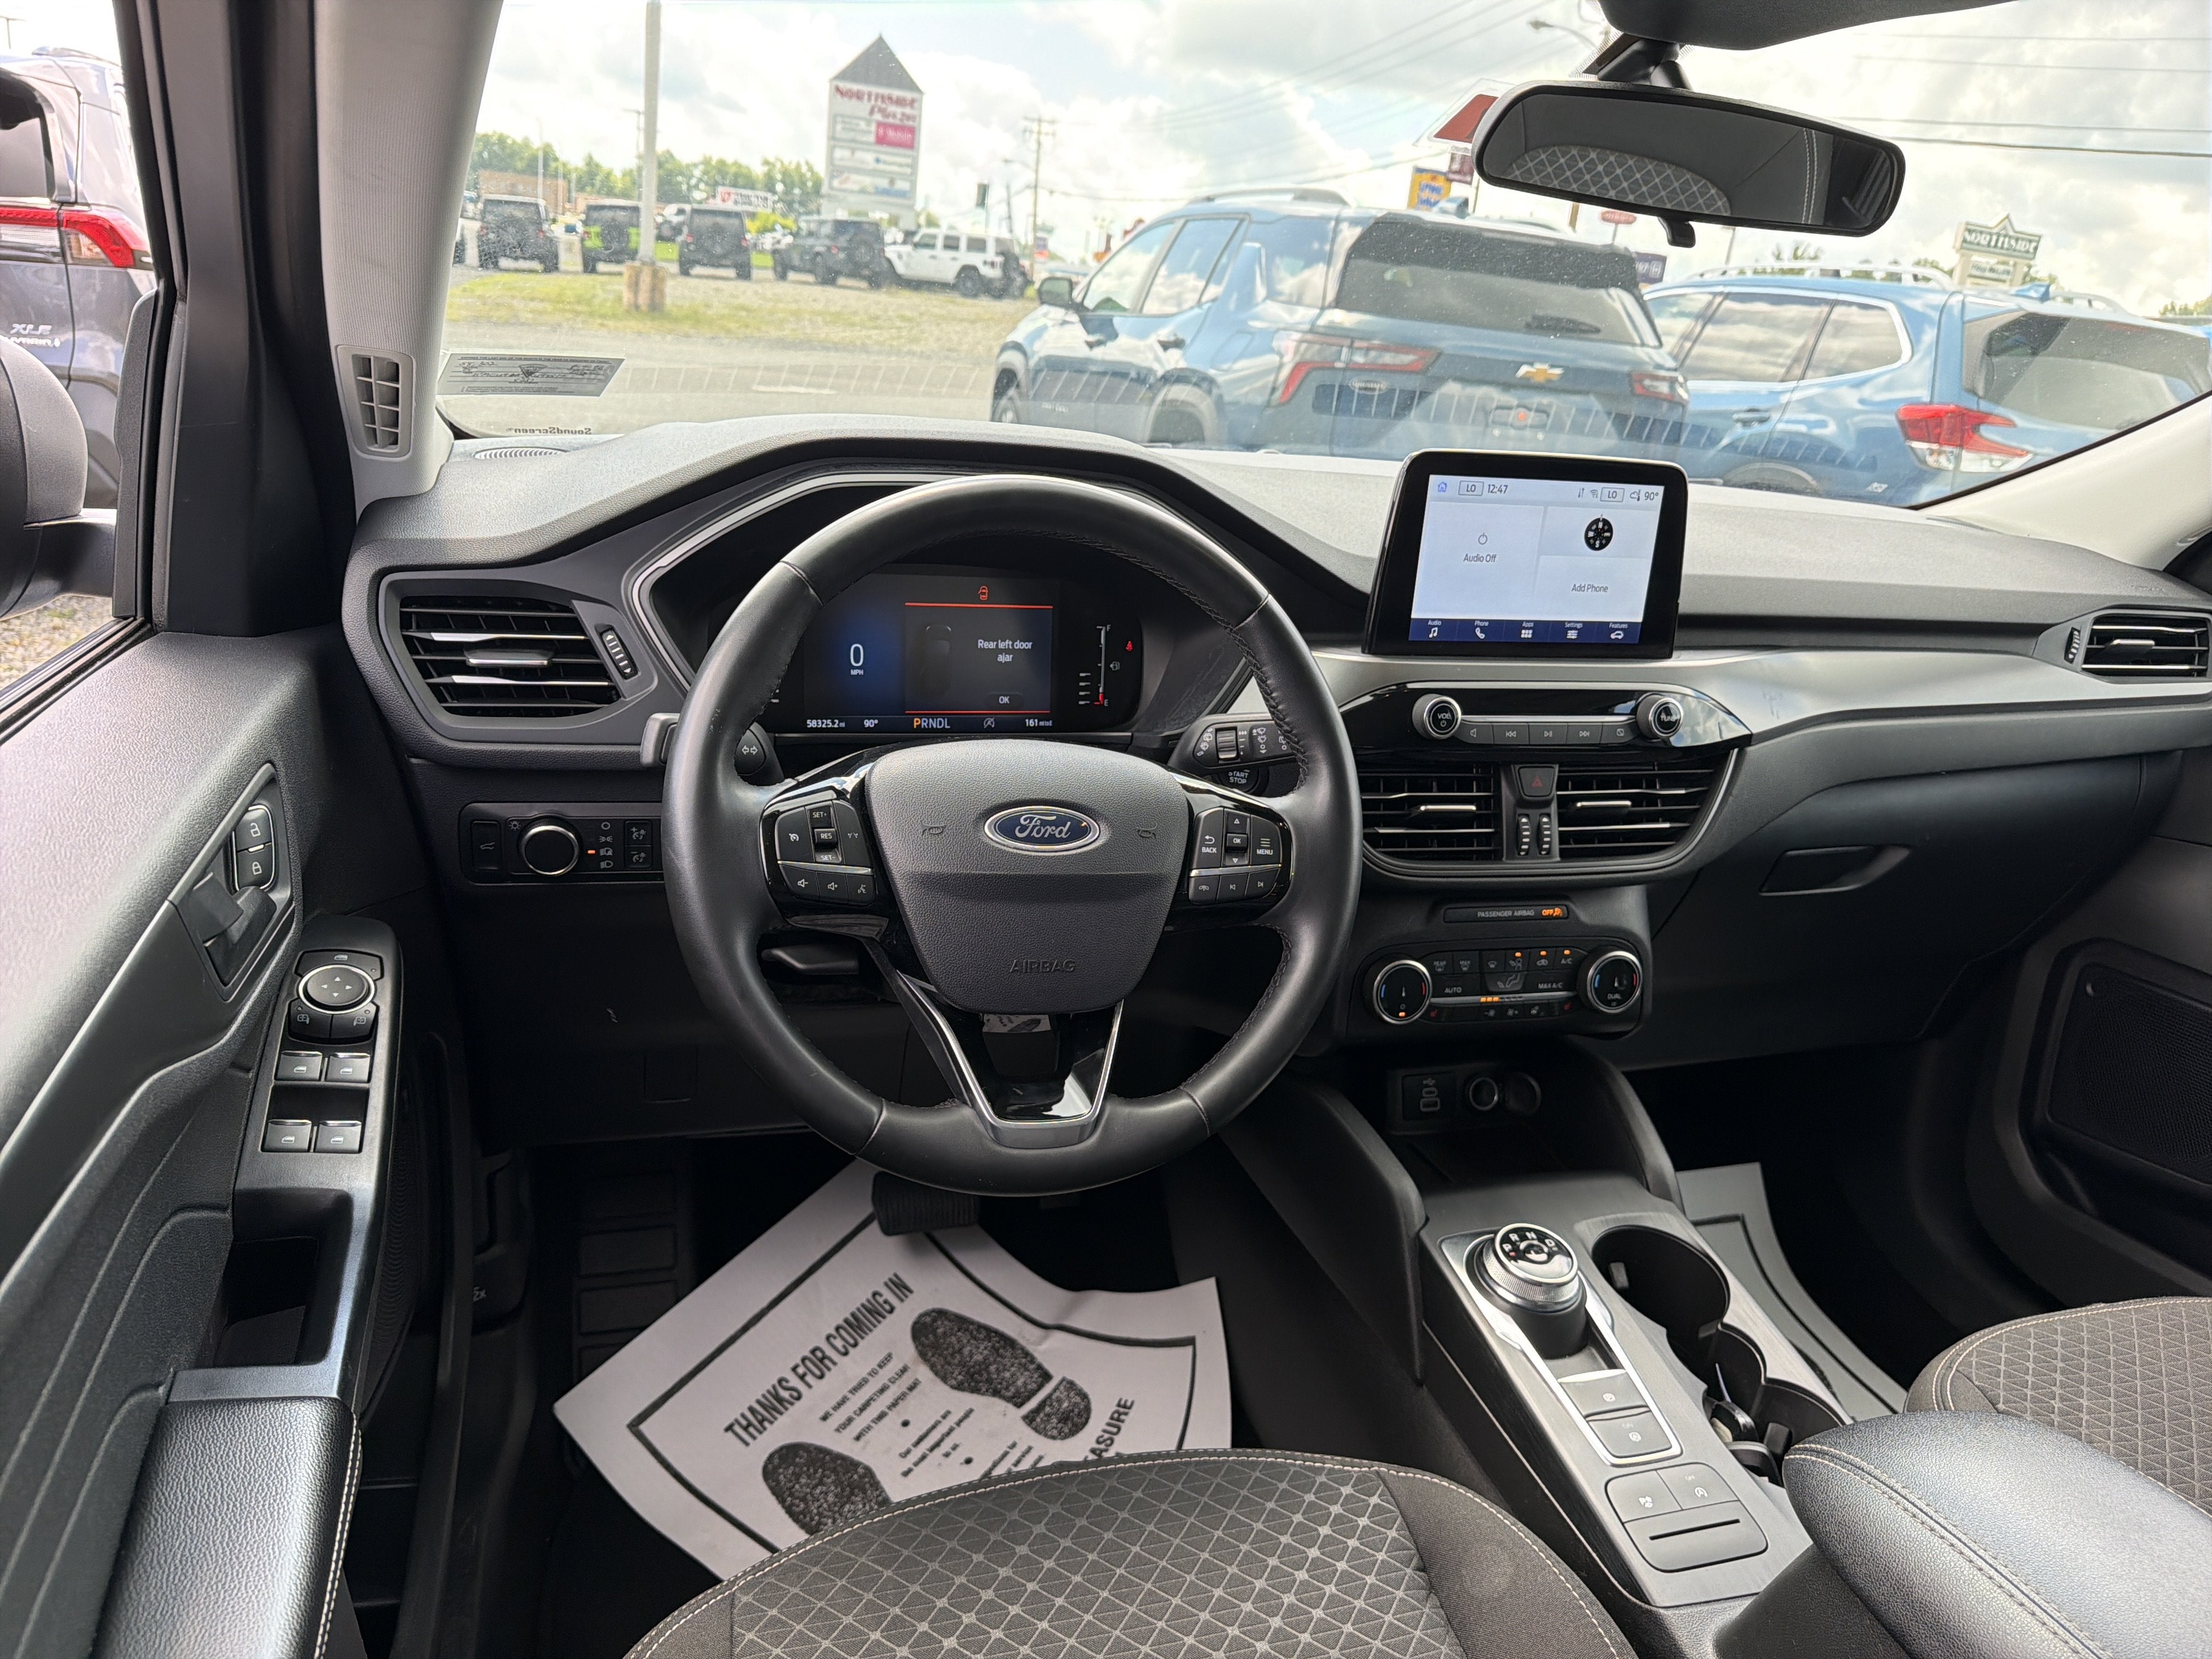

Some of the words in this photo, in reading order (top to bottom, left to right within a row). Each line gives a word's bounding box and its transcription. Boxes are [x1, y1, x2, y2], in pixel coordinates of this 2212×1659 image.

[834, 84, 917, 109] NORTHSIDE
[10, 323, 52, 335] XLE
[1466, 484, 1476, 492] LO
[1487, 484, 1508, 494] 12:47
[1607, 490, 1617, 499] LO
[1644, 492, 1659, 501] 90°
[1463, 554, 1484, 562] Audio
[1485, 554, 1497, 563] Off
[1571, 583, 1586, 592] Add
[1587, 584, 1609, 593] Phone
[978, 639, 997, 648] Rear
[998, 639, 1013, 649] left
[1014, 640, 1032, 650] door
[850, 644, 864, 667] 0
[997, 653, 1013, 663] ajar
[806, 719, 839, 728] 58325.2
[864, 719, 878, 728] 90°
[1025, 719, 1038, 727] 161
[1228, 770, 1249, 778] START
[1014, 814, 1072, 839] Ford
[1009, 959, 1076, 973] AIRBAG
[1509, 1233, 1520, 1242] R
[1525, 1231, 1537, 1240] N
[1545, 1239, 1555, 1248] D
[724, 1376, 804, 1447] THANKS
[790, 1345, 838, 1389] FOR
[825, 1289, 896, 1357] COMING
[883, 1272, 914, 1303] IN
[820, 1409, 832, 1423] WE
[831, 1394, 850, 1412] HAVE
[848, 1376, 870, 1396] TRIED
[867, 1367, 879, 1380] TO
[877, 1351, 894, 1370] KEEP
[834, 1414, 855, 1433] YOUR
[853, 1383, 890, 1418] CARPETING
[887, 1363, 911, 1385] CLEAN
[853, 1425, 874, 1442] WITH
[871, 1409, 889, 1425] THIS
[885, 1390, 909, 1412] PAPER
[906, 1377, 922, 1393] MAT
[1083, 1397, 1135, 1463] ASURE
